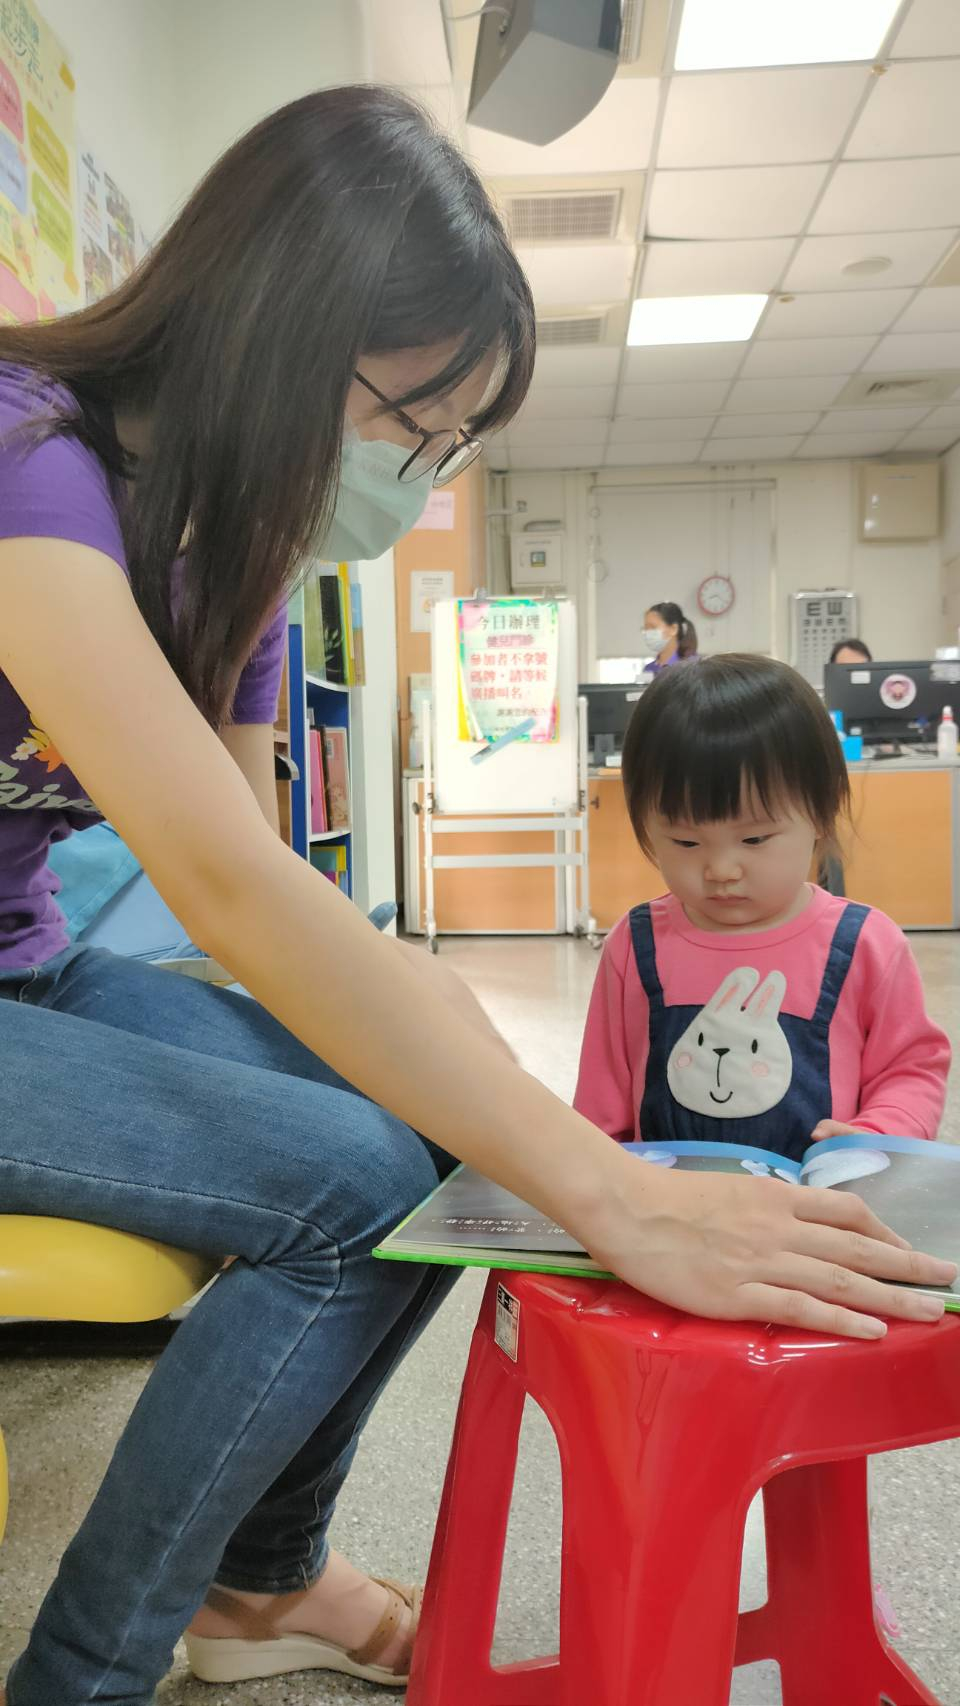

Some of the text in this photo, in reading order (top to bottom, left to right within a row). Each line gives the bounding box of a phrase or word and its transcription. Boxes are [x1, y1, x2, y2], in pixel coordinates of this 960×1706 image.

[479, 614, 540, 630] 今日辦理
[470, 652, 548, 666] 參加者不拿號
